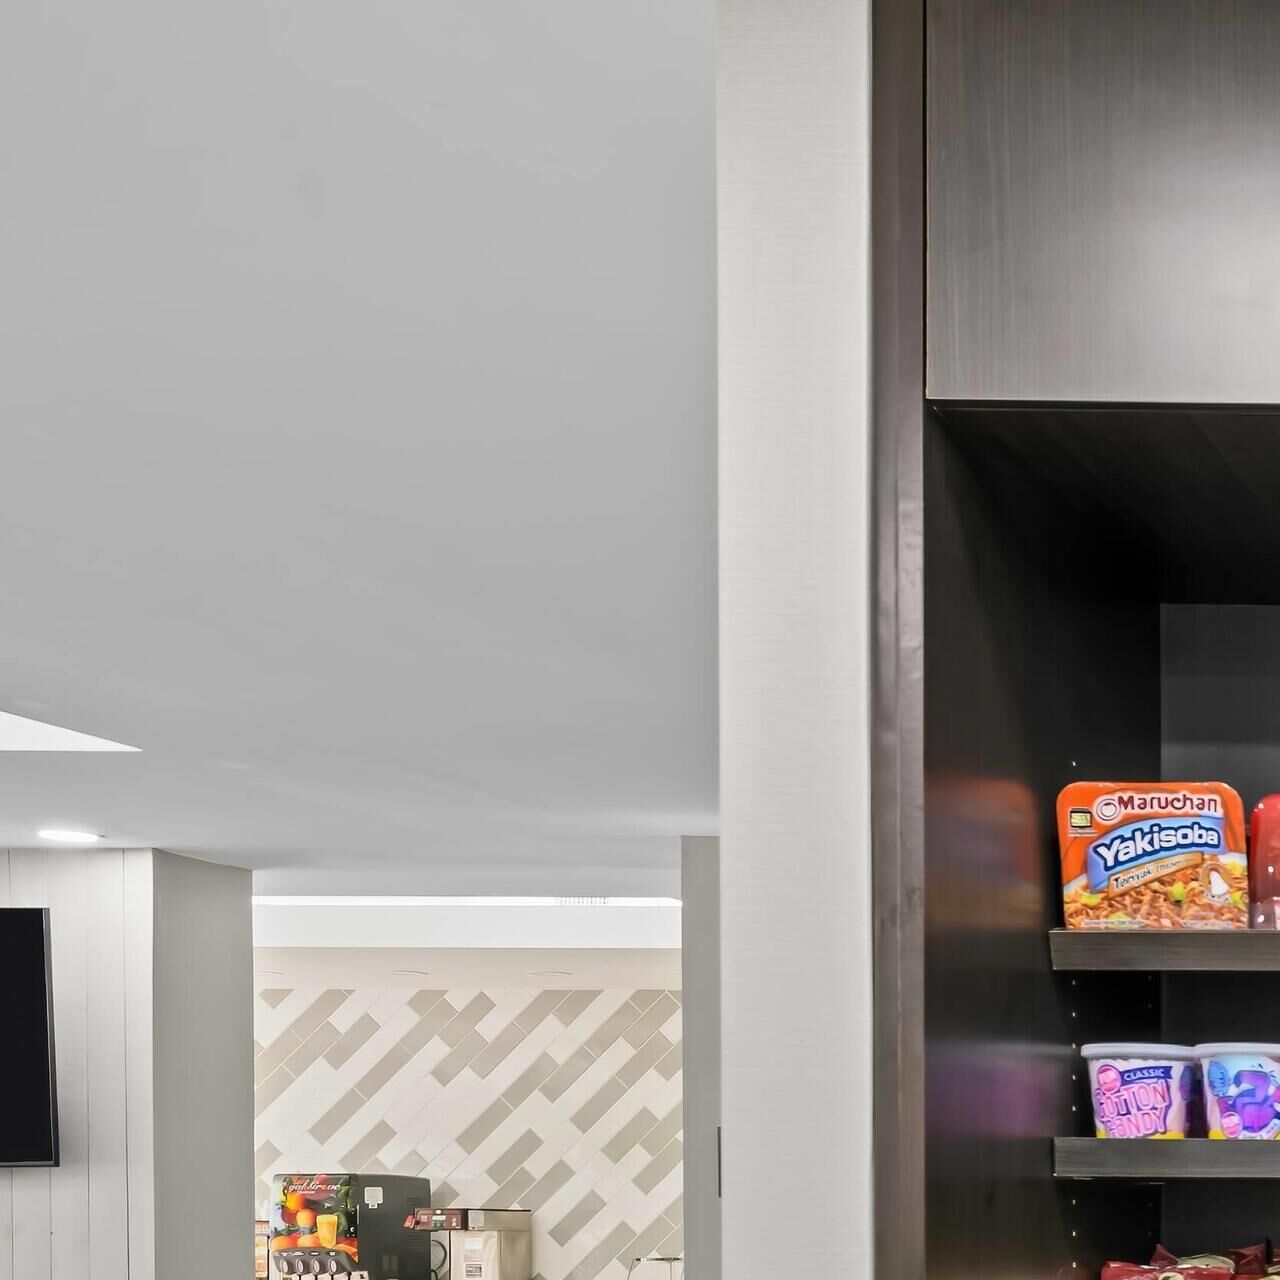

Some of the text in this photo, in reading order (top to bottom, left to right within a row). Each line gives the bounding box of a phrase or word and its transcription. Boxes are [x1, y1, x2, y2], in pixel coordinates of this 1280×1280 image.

[1118, 793, 1219, 813] Maruchan
[1096, 821, 1220, 869] Yakisoba
[1124, 1068, 1165, 1080] CLASSIC
